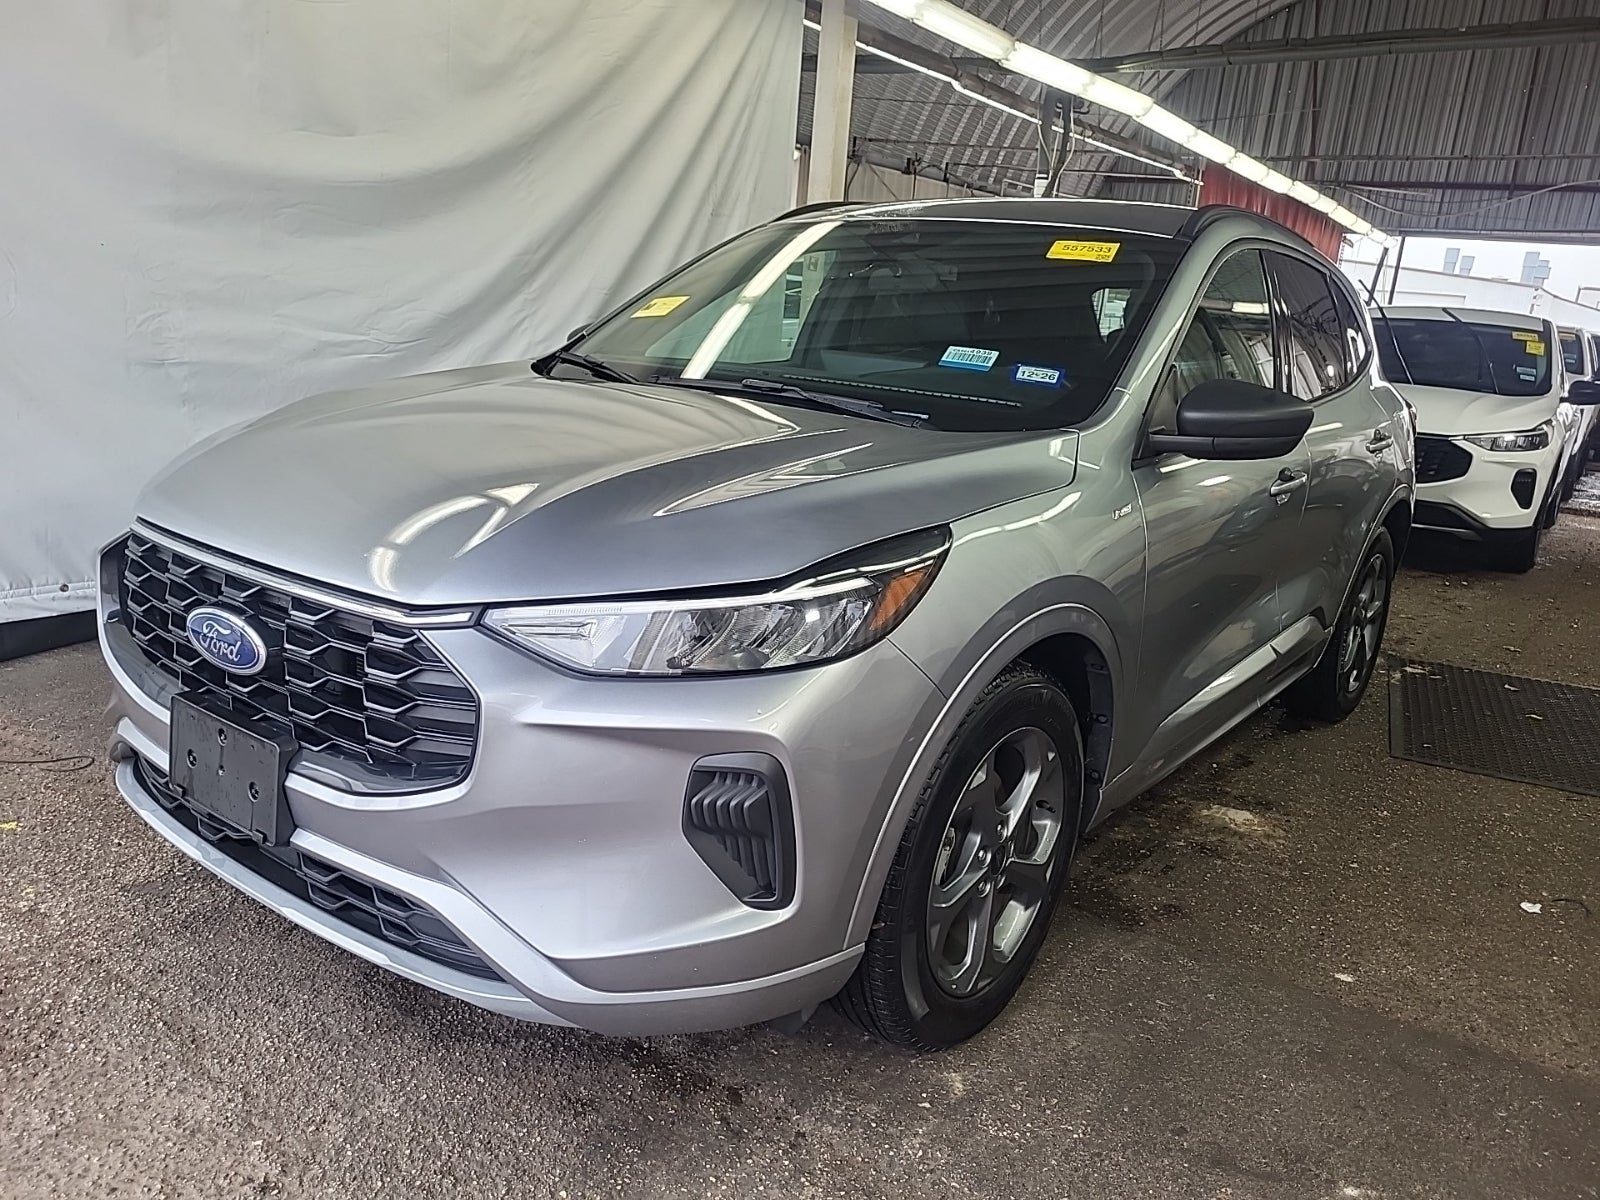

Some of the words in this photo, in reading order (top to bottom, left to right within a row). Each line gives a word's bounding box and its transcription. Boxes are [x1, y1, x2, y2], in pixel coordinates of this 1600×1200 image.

[1062, 244, 1113, 254] 557533
[1040, 372, 1057, 381] 26
[199, 620, 242, 662] Ford
